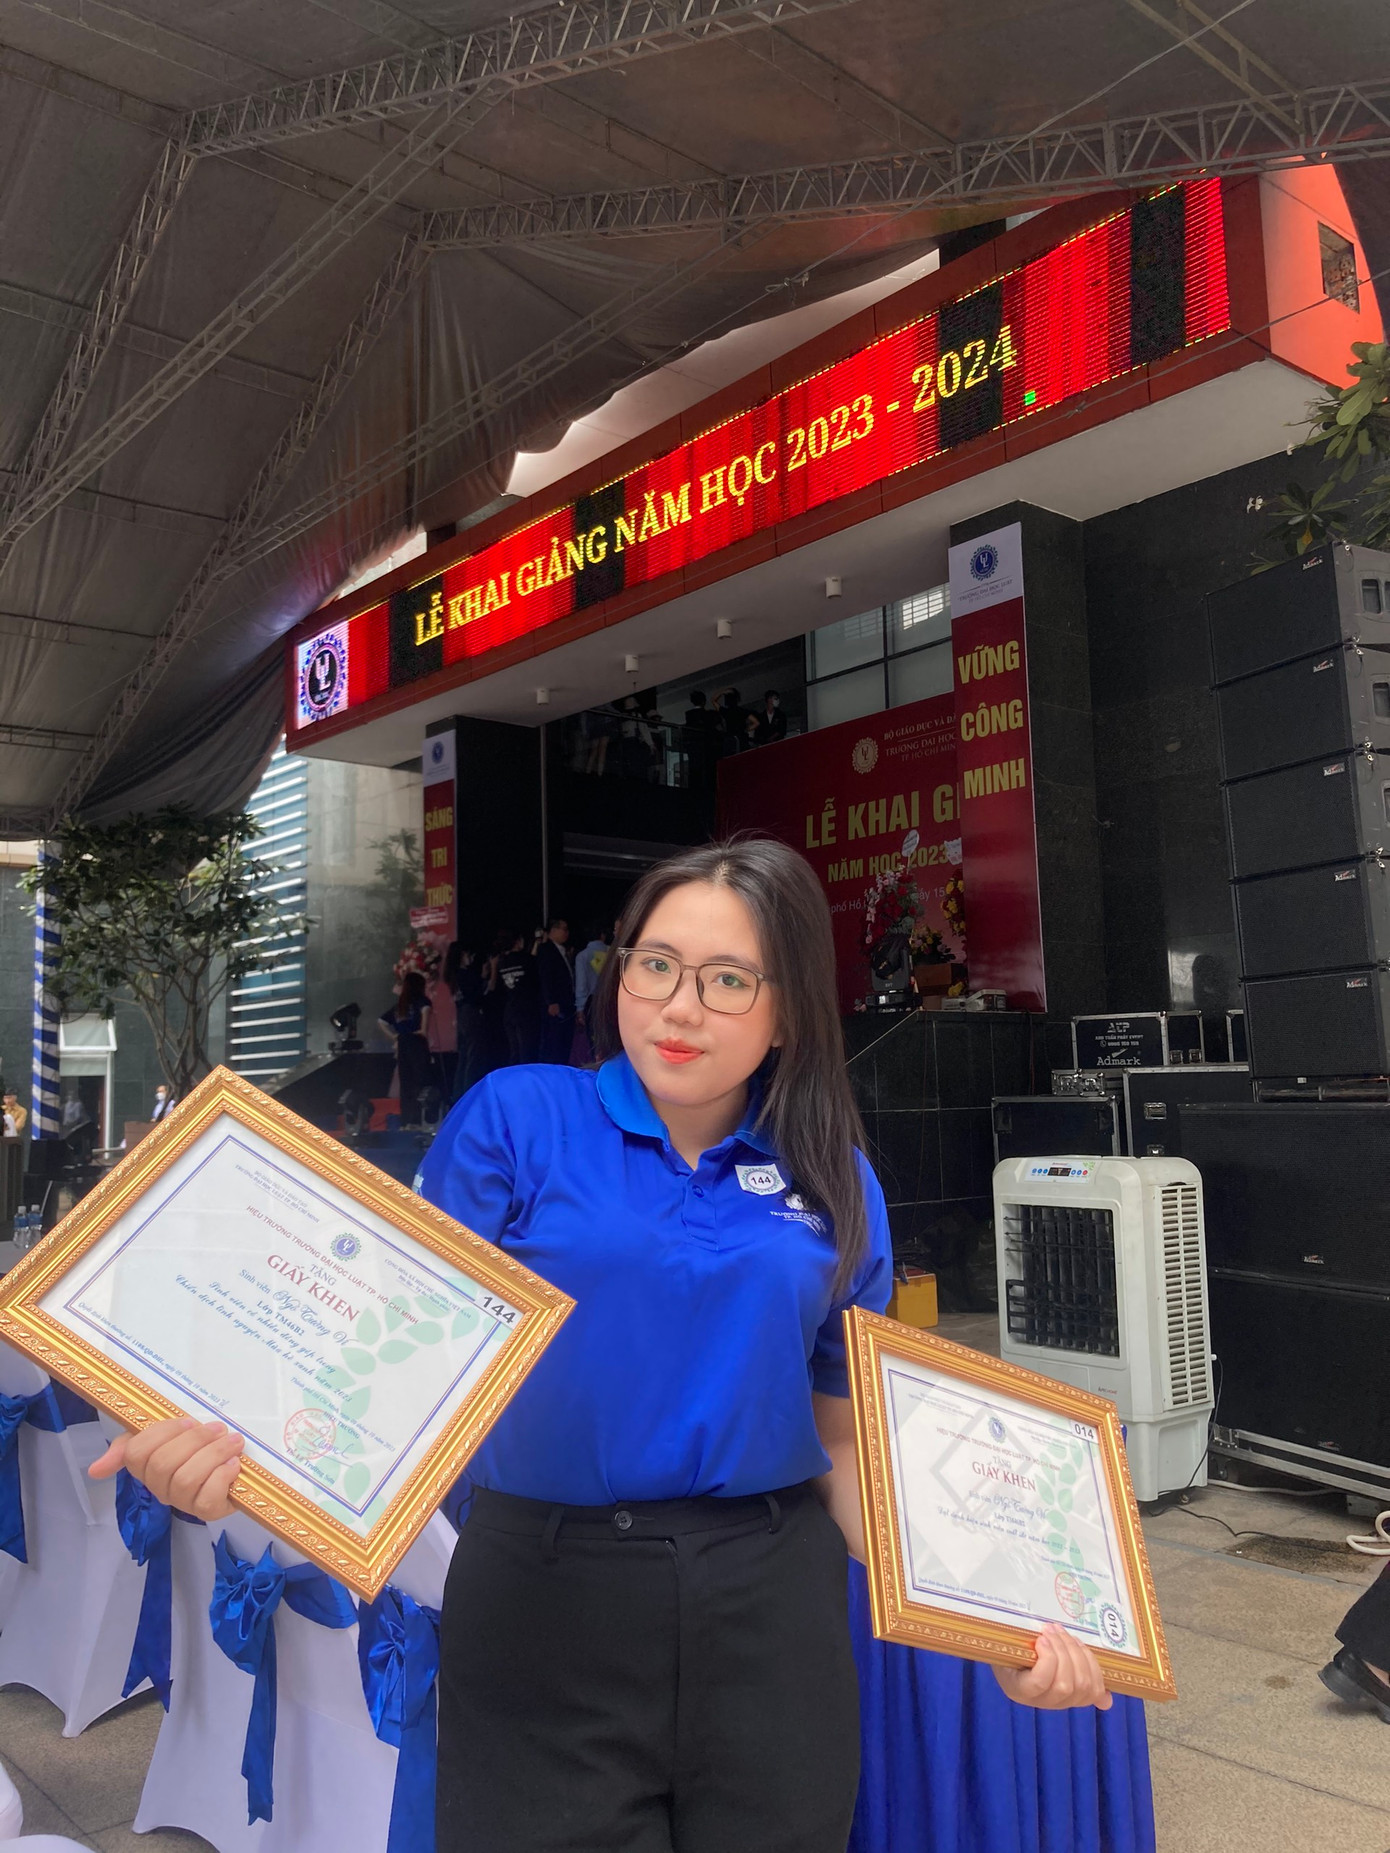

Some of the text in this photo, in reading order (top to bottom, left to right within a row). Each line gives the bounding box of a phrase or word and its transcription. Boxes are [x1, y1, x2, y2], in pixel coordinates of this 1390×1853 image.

[415, 325, 1017, 646] LỄ KHAI GIẢNG NĂM HỌC 2023 - 2024
[957, 640, 1020, 684] VỮNG
[960, 699, 1024, 741] CÔNG
[963, 758, 1026, 799] MINH
[425, 806, 453, 832] SÁNG
[806, 797, 837, 849] LỄ
[848, 790, 920, 841] KHAI
[431, 846, 447, 868] TRI
[827, 858, 864, 883] NĂM
[427, 882, 452, 906] THỨC
[1097, 1056, 1141, 1066] Admark
[750, 1176, 771, 1185] 144
[238, 1268, 257, 1284] Sinh
[254, 1279, 272, 1294] viên
[265, 1253, 310, 1287] GIẤY
[307, 1281, 360, 1322] KHEN
[306, 1262, 338, 1287] TẶNG
[255, 1299, 274, 1315] Lớp
[484, 1296, 516, 1323] 144
[1074, 1424, 1095, 1439] 014
[971, 1460, 1036, 1491] GIẤY KHEN
[1107, 1613, 1118, 1638] 014
